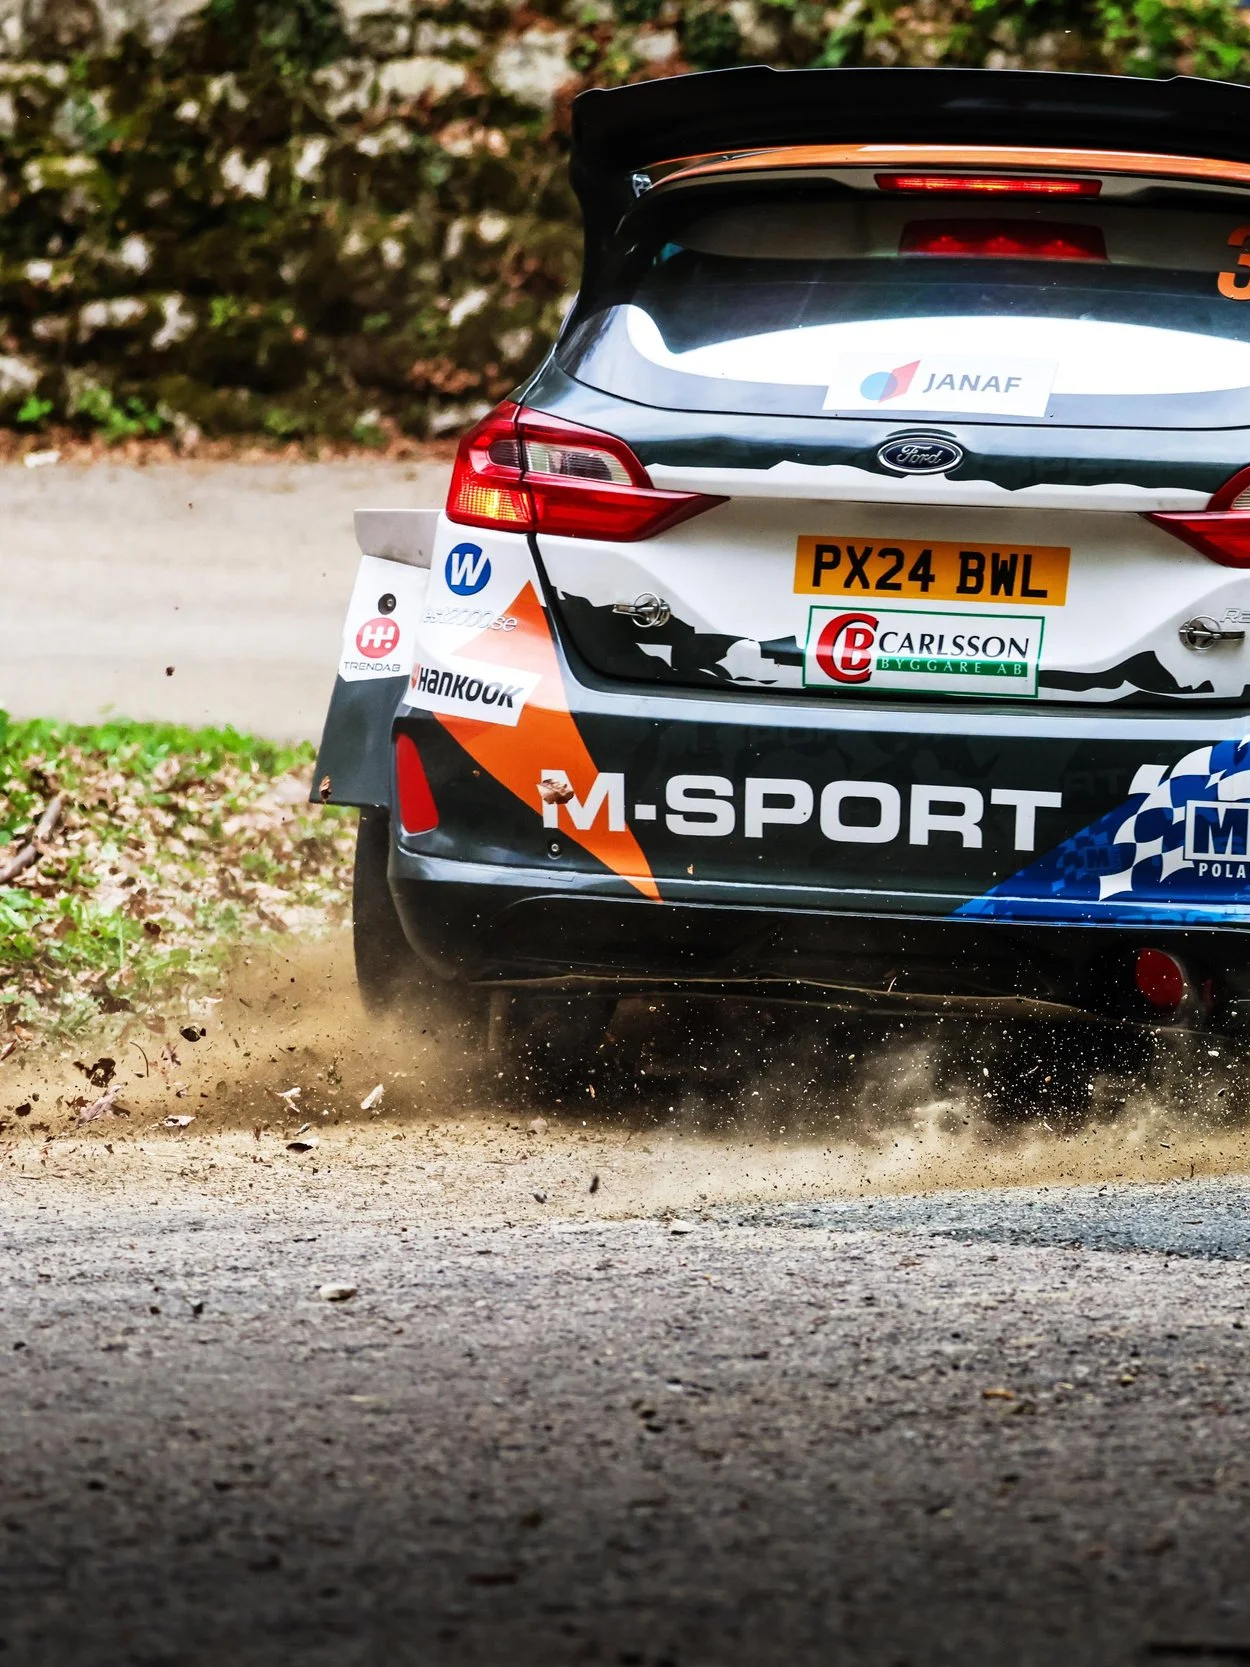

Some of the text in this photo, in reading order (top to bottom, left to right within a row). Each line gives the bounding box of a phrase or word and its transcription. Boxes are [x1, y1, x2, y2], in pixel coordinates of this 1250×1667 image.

[922, 372, 1023, 394] JANAF
[895, 444, 945, 465] Ford
[811, 543, 1049, 599] PX24 BWL
[878, 631, 1030, 659] CARLSSON
[343, 661, 401, 672] TRENDAB
[880, 657, 1023, 675] BYGGARE AB
[540, 768, 1063, 851] M-SPORT
